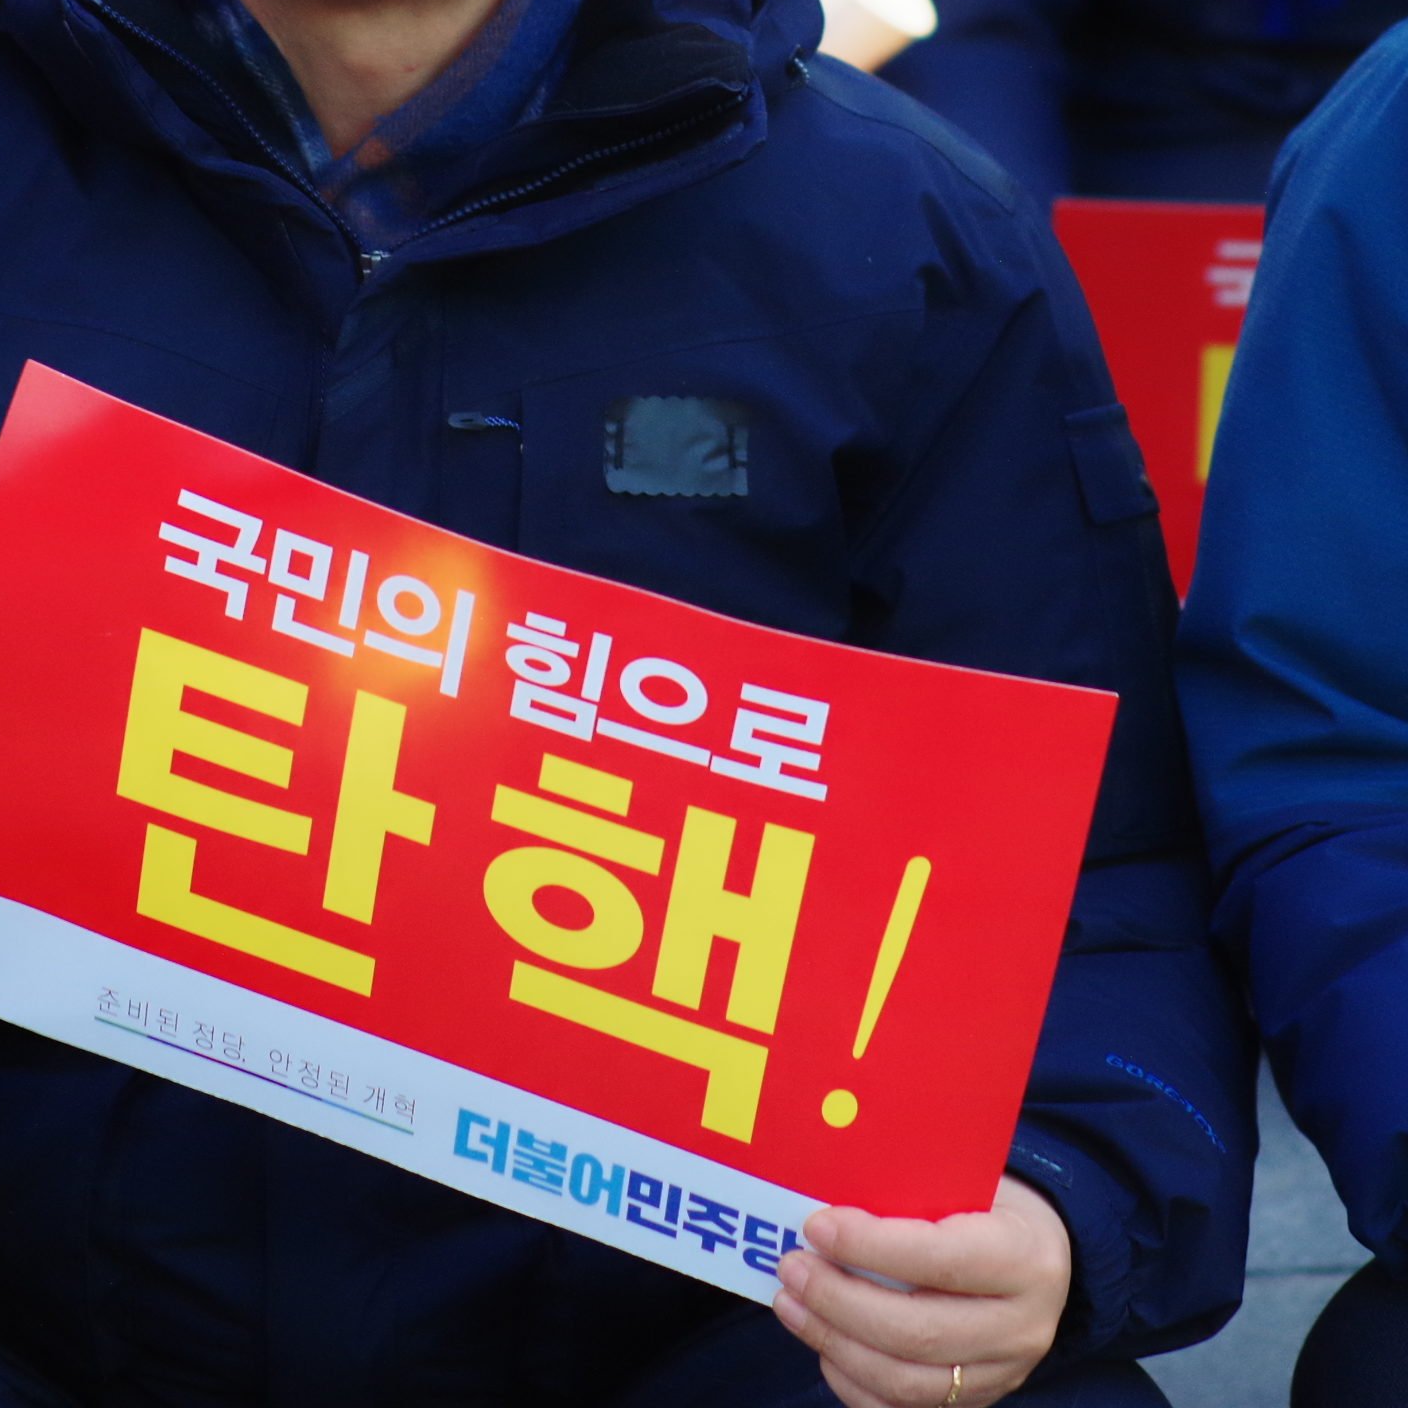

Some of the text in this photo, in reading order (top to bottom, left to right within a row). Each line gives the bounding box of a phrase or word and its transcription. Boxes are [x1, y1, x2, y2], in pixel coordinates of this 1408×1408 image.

[159, 489, 830, 802] 국민의 힘으로
[94, 986, 179, 1038] 준비된
[268, 1047, 351, 1101] 안정된
[363, 1083, 417, 1125] 개혁
